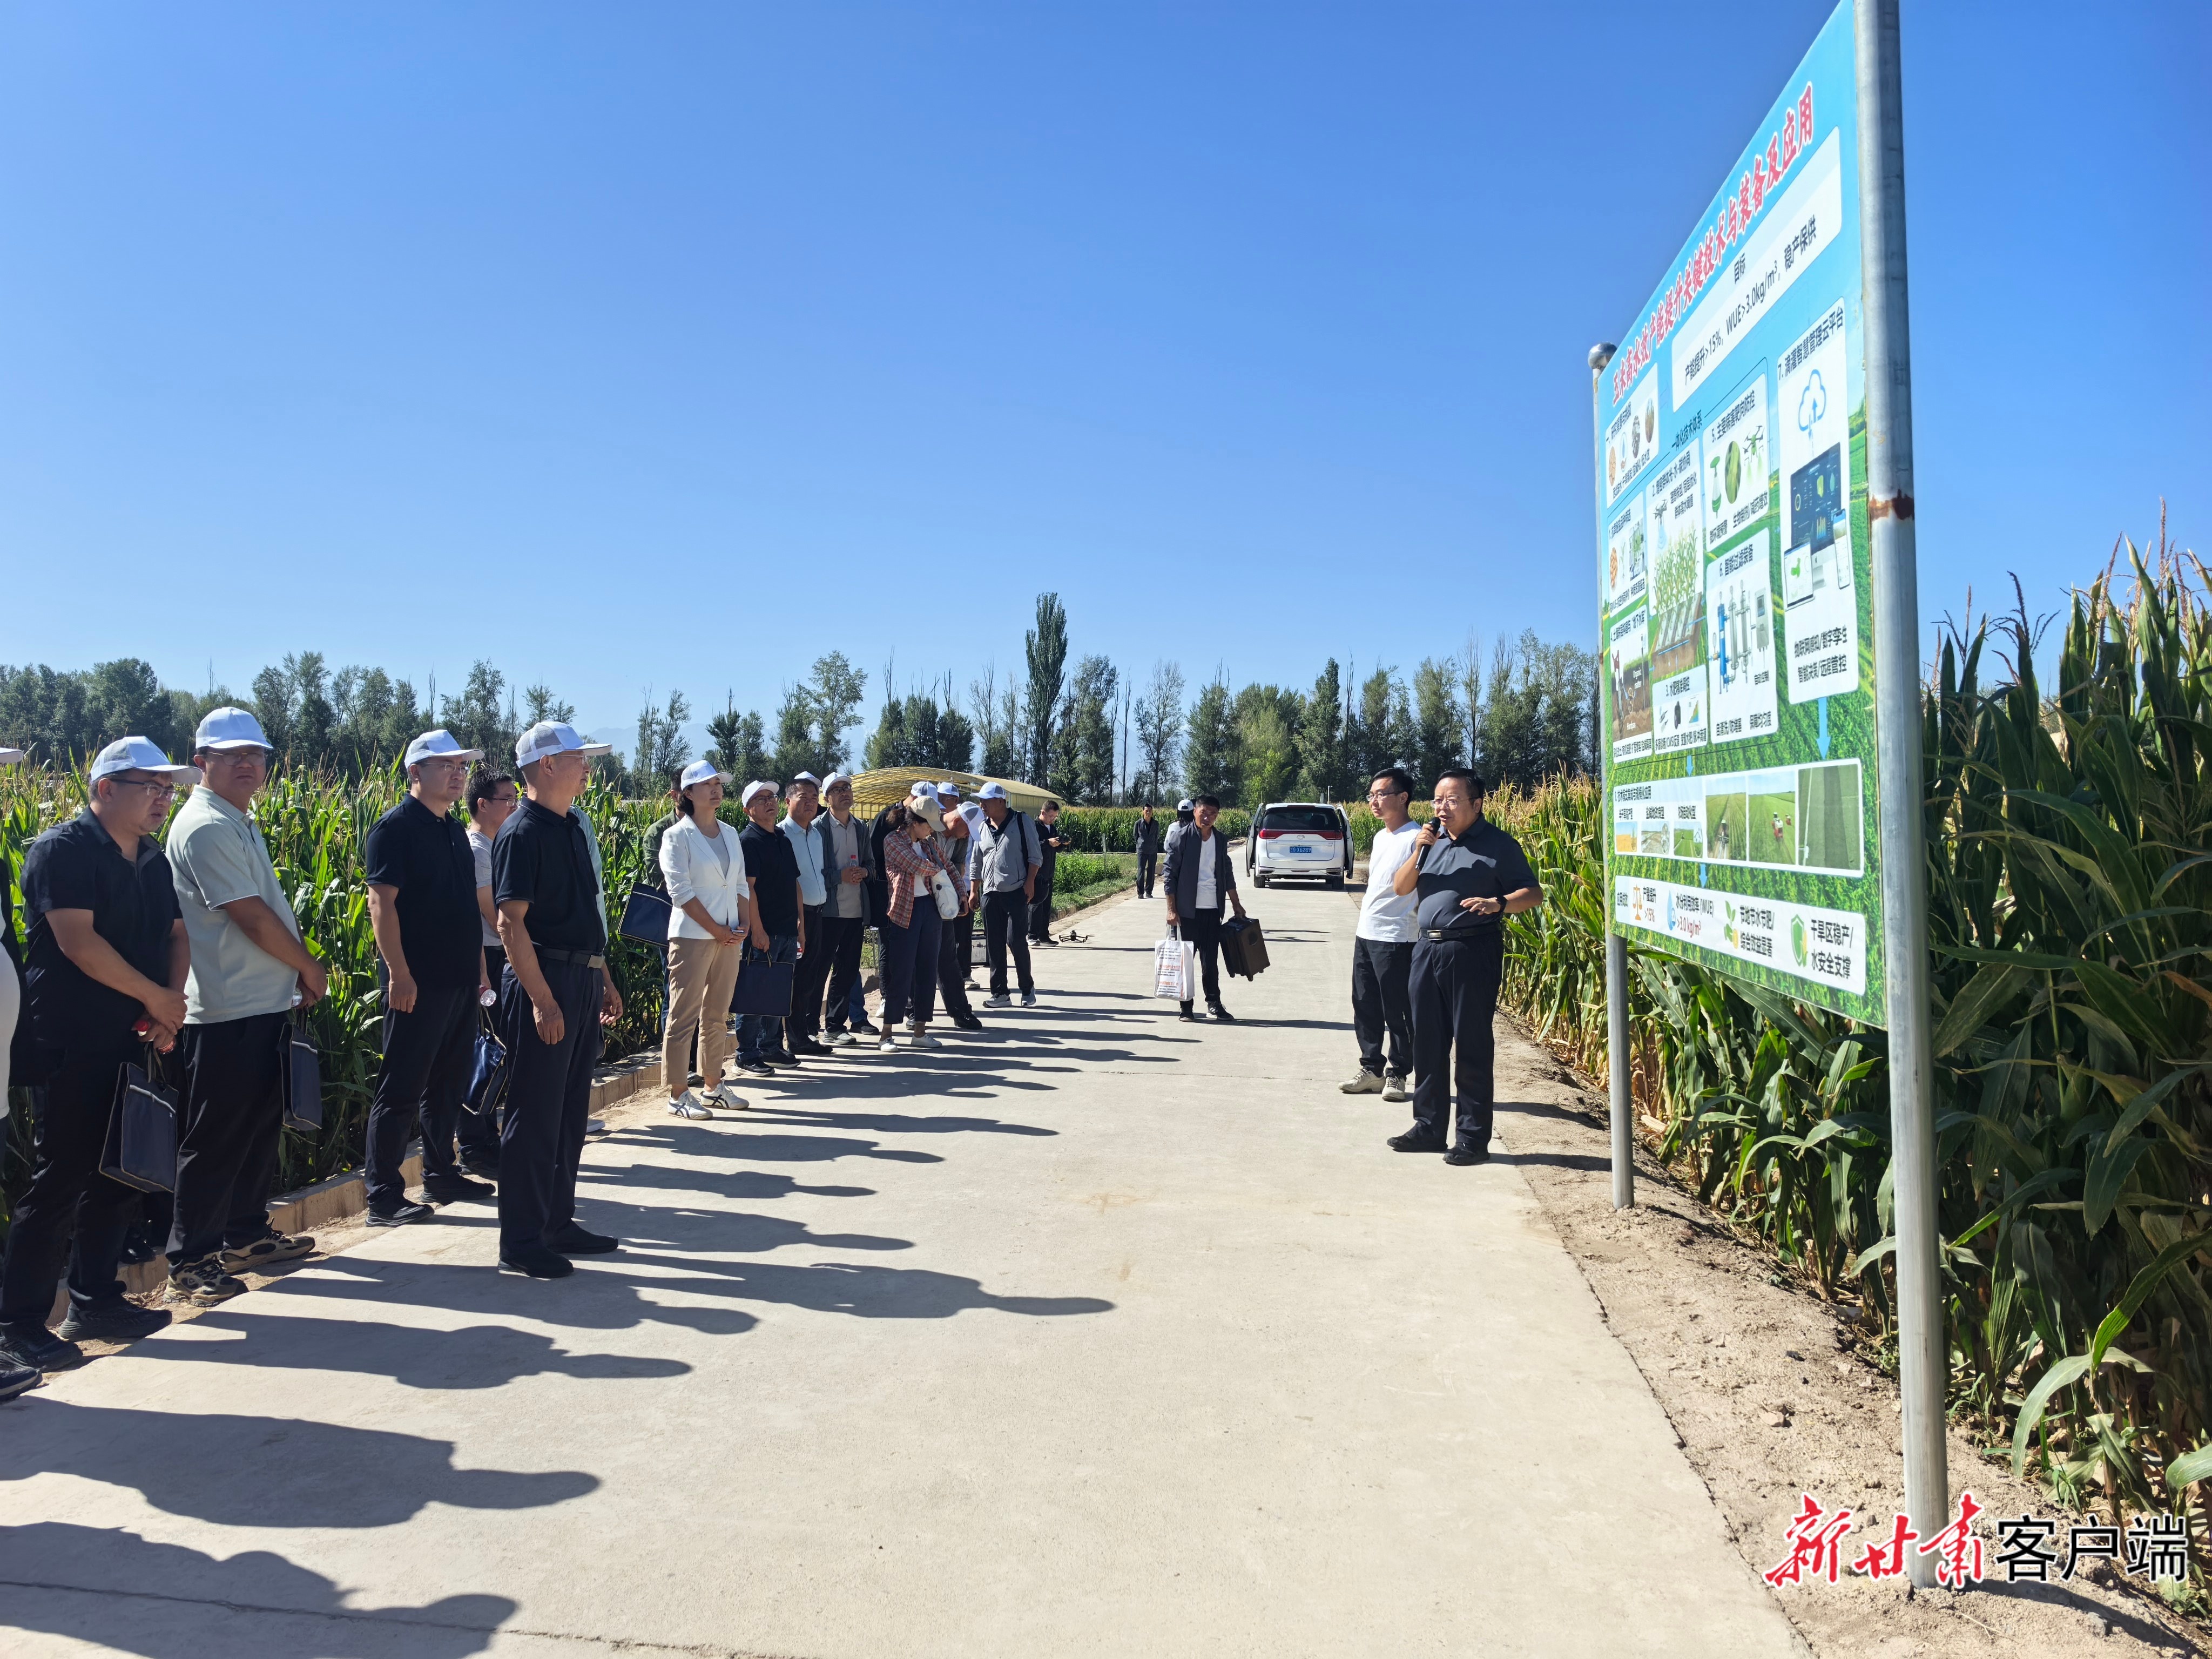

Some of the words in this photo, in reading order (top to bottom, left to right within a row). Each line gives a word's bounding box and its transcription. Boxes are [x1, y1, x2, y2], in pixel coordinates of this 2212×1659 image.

[1613, 82, 1813, 406] 玉米高水效产能提升关键技术与装备及应用
[1734, 252, 1745, 284] 目标
[1778, 360, 1783, 382] 7.
[1784, 306, 1843, 377] 滴灌智慧管理云平台
[1671, 408, 1702, 451] 一体化技术体系
[1716, 389, 1755, 440] 主要病害靶向防控
[1724, 543, 1754, 577] 智能过滤装备
[1794, 623, 1847, 661] 物联网感知/数字孪生
[1797, 652, 1847, 685] 智能决策/远程管控
[1642, 886, 1656, 905] 产量提升
[1675, 893, 1699, 915] 水分利用效率
[1700, 898, 1714, 920] (WUE)
[1644, 907, 1655, 924] >15%
[1677, 915, 1686, 933] >3.0
[1739, 906, 1775, 931] 节地节水节肥/
[1740, 933, 1772, 957] 综合效益显著
[1811, 919, 1854, 948] 干旱区稳产/
[1811, 950, 1851, 979] 水安全支撑
